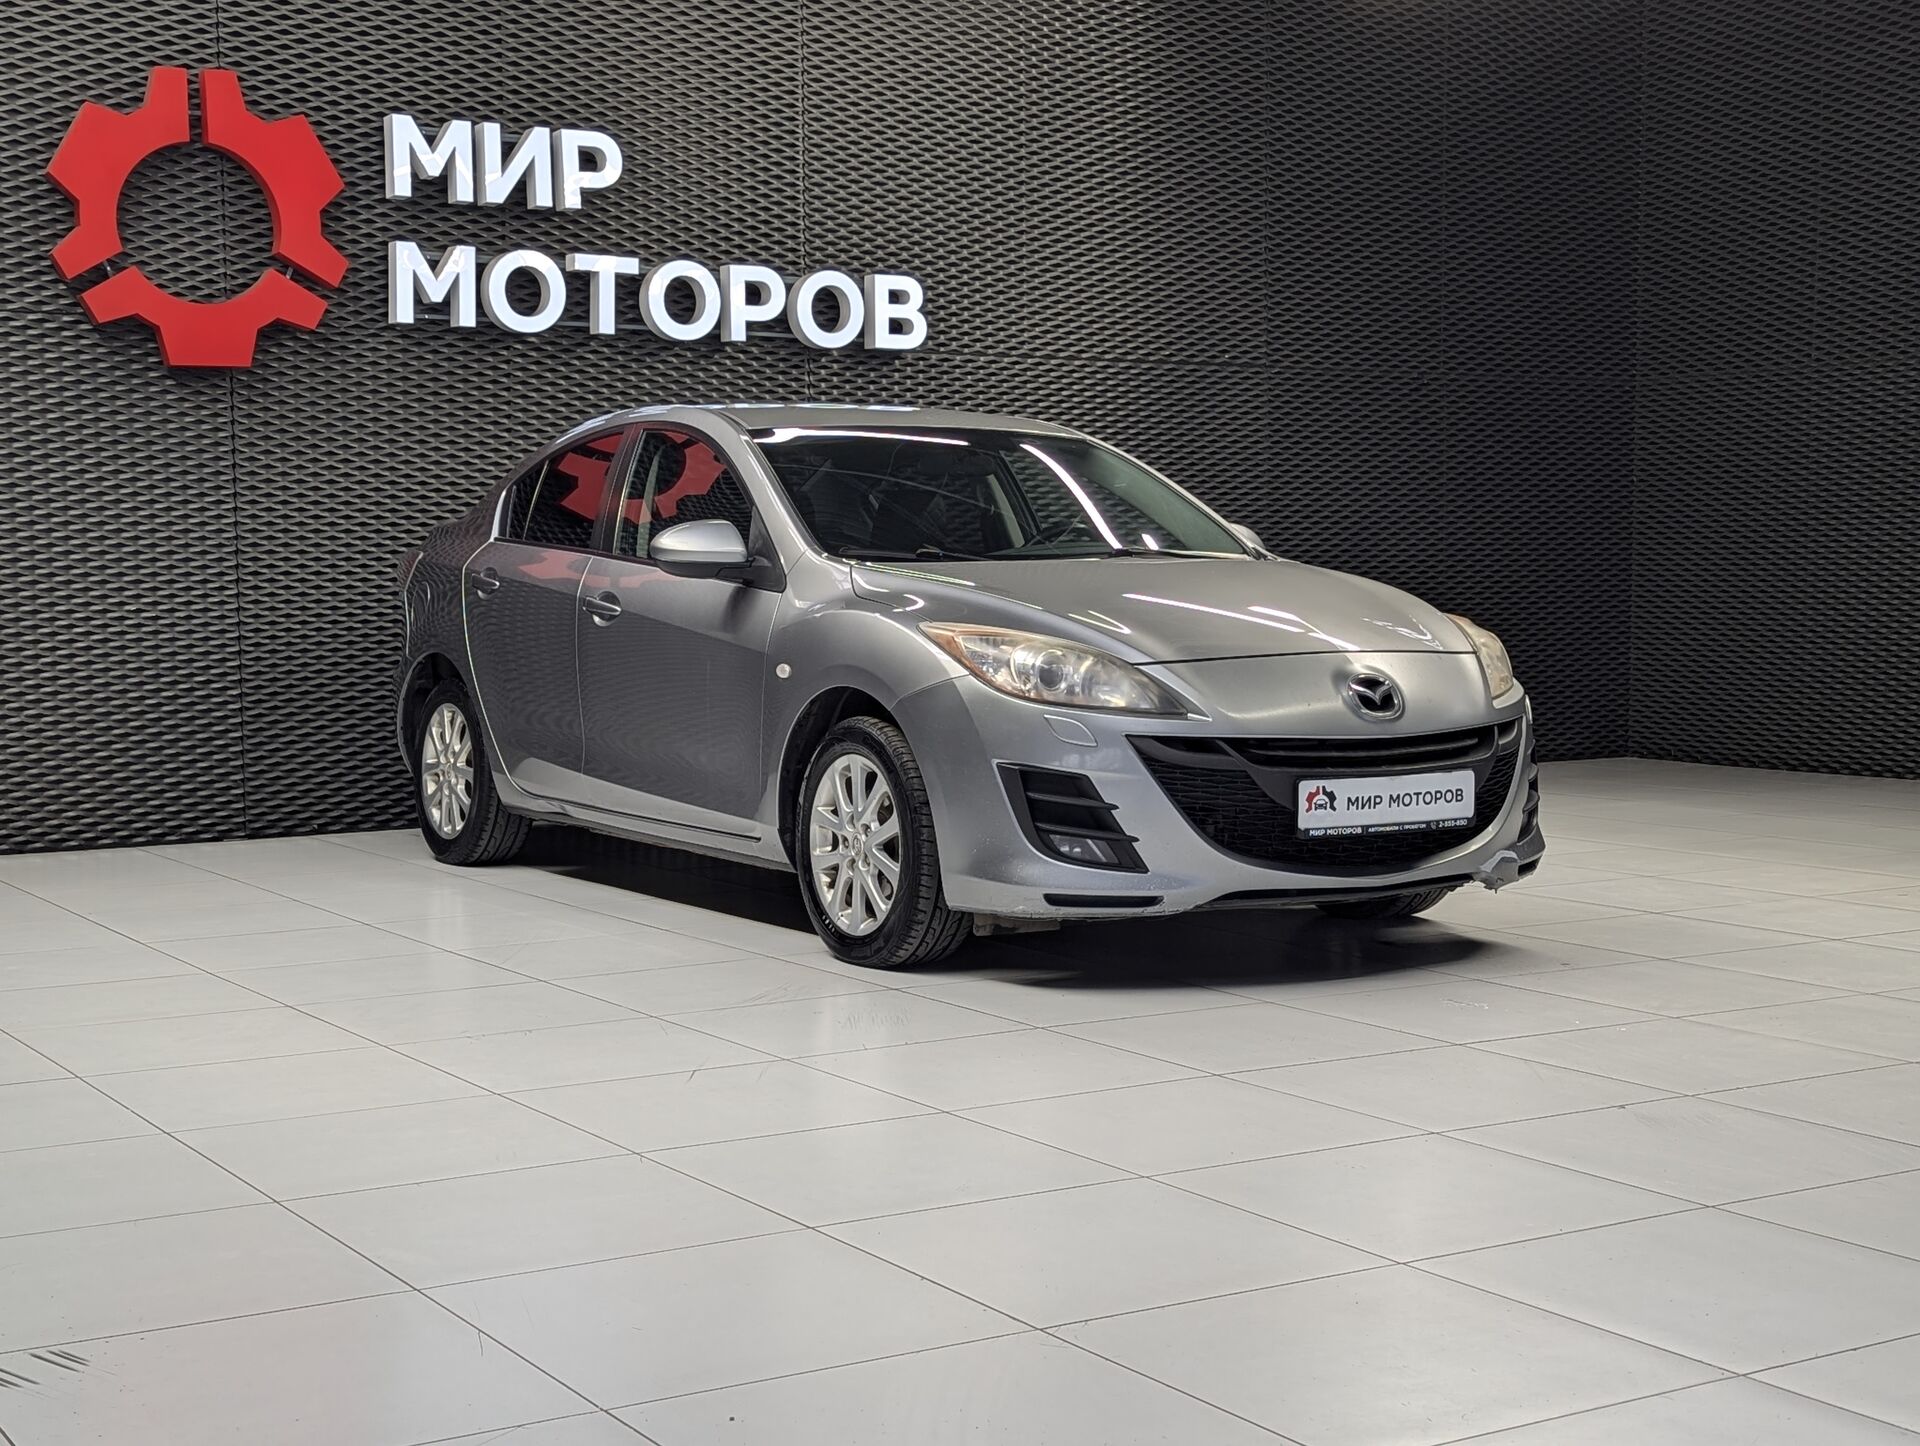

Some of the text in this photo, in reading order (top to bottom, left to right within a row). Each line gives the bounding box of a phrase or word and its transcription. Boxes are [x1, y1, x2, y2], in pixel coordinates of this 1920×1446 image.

[383, 113, 624, 210] МИР
[387, 240, 929, 350] МОТОРОВ
[1346, 788, 1464, 812] МИР МОТОРОВ
[1309, 828, 1326, 837] МИР
[1327, 826, 1362, 836] МОТОРОВ
